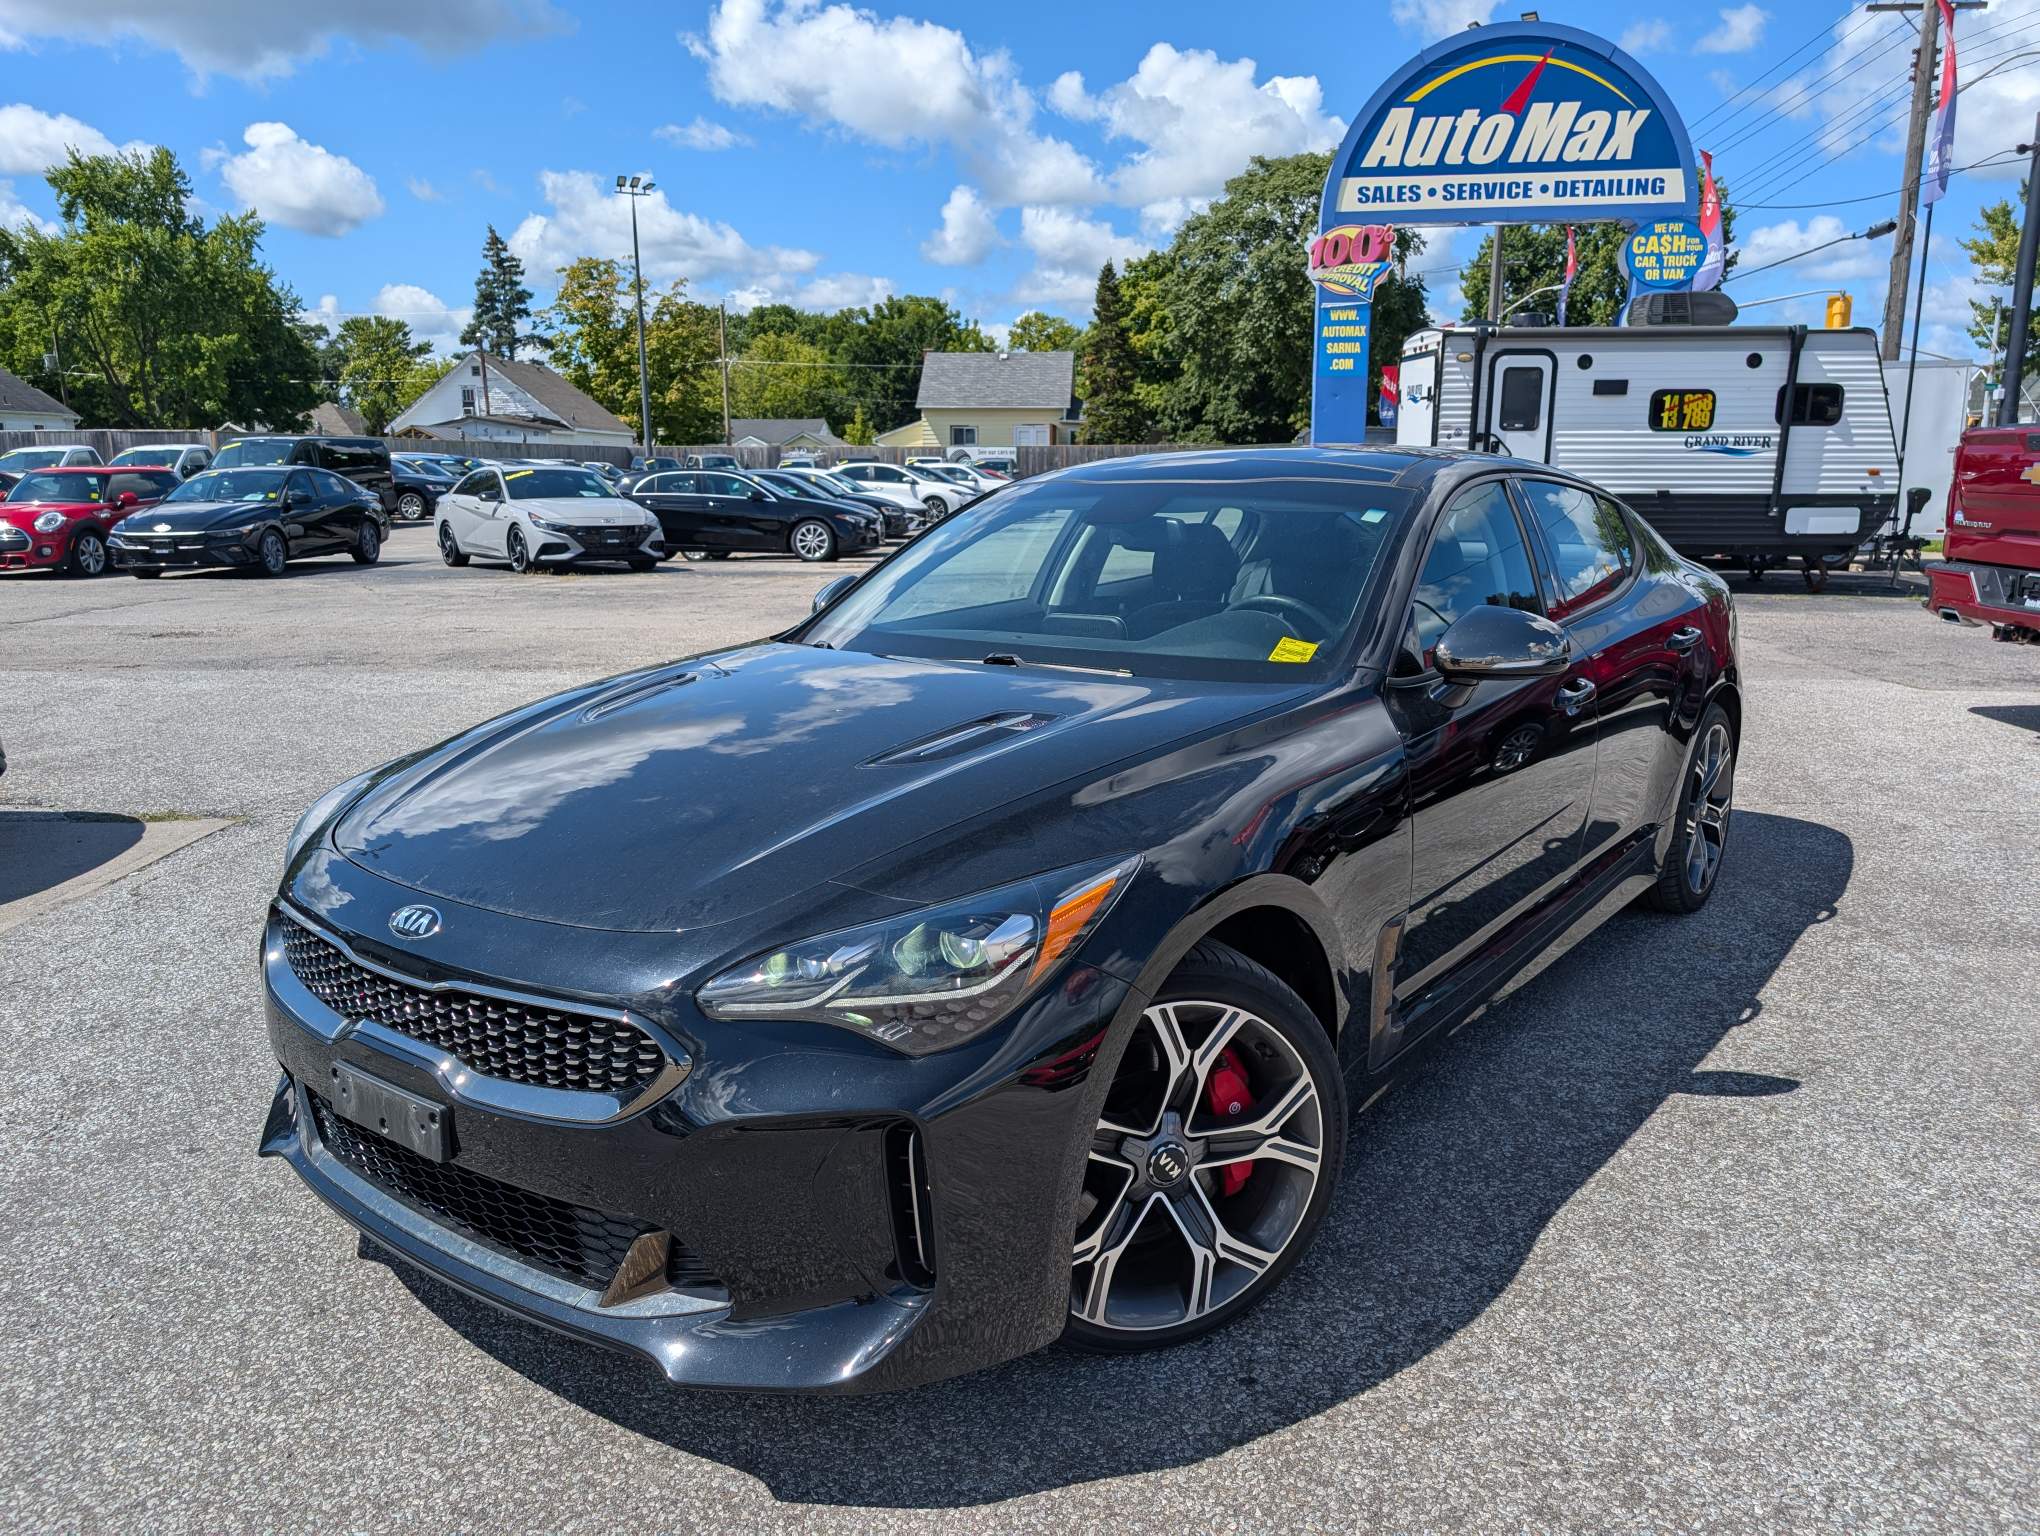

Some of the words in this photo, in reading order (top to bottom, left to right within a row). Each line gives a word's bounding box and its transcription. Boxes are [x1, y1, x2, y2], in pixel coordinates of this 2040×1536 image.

[1357, 184, 1421, 204] SALES
[1442, 180, 1533, 201] SERVICE
[1553, 177, 1665, 198] DETAILING
[1654, 224, 1667, 233] WE
[1669, 224, 1683, 233] PAY
[1311, 224, 1396, 269] 100%
[1632, 234, 1687, 255] CA$H
[1663, 255, 1697, 267] TRUCK
[1334, 262, 1381, 276] CREDIT
[1645, 269, 1660, 280] OR
[1330, 310, 1359, 320] WWW.
[1322, 326, 1366, 337] AUTOMAX
[1326, 342, 1360, 354] SARNIA
[1329, 359, 1354, 370] .COM
[1660, 411, 1678, 428] 13
[1682, 410, 1711, 429] 789
[1684, 435, 1729, 448] GRAND
[1732, 435, 1772, 448] RIVER
[393, 907, 433, 934] KIA
[1159, 1152, 1182, 1178] KIA
